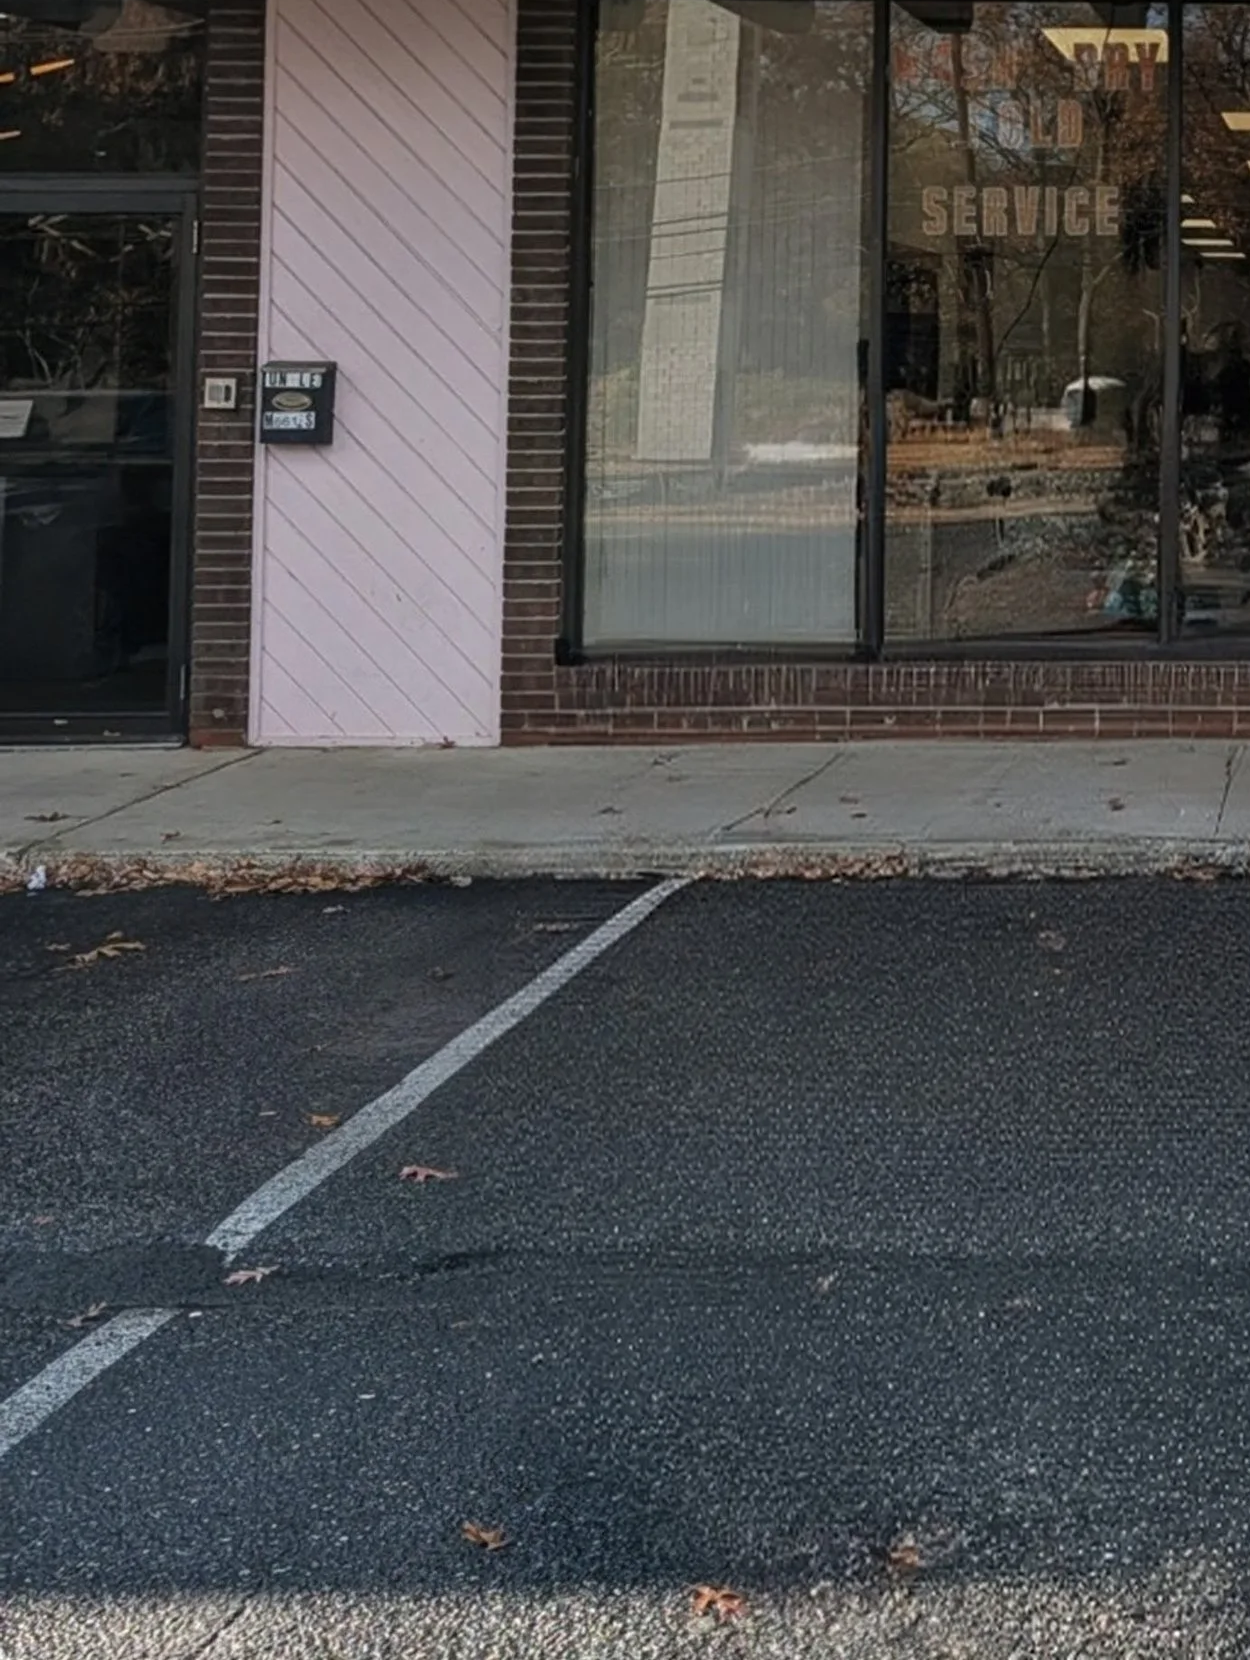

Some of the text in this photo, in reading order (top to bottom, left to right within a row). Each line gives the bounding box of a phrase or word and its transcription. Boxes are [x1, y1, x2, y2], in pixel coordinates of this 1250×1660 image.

[1073, 42, 1160, 90] DRY
[974, 99, 1083, 149] OLD
[920, 185, 1120, 237] SERVICE
